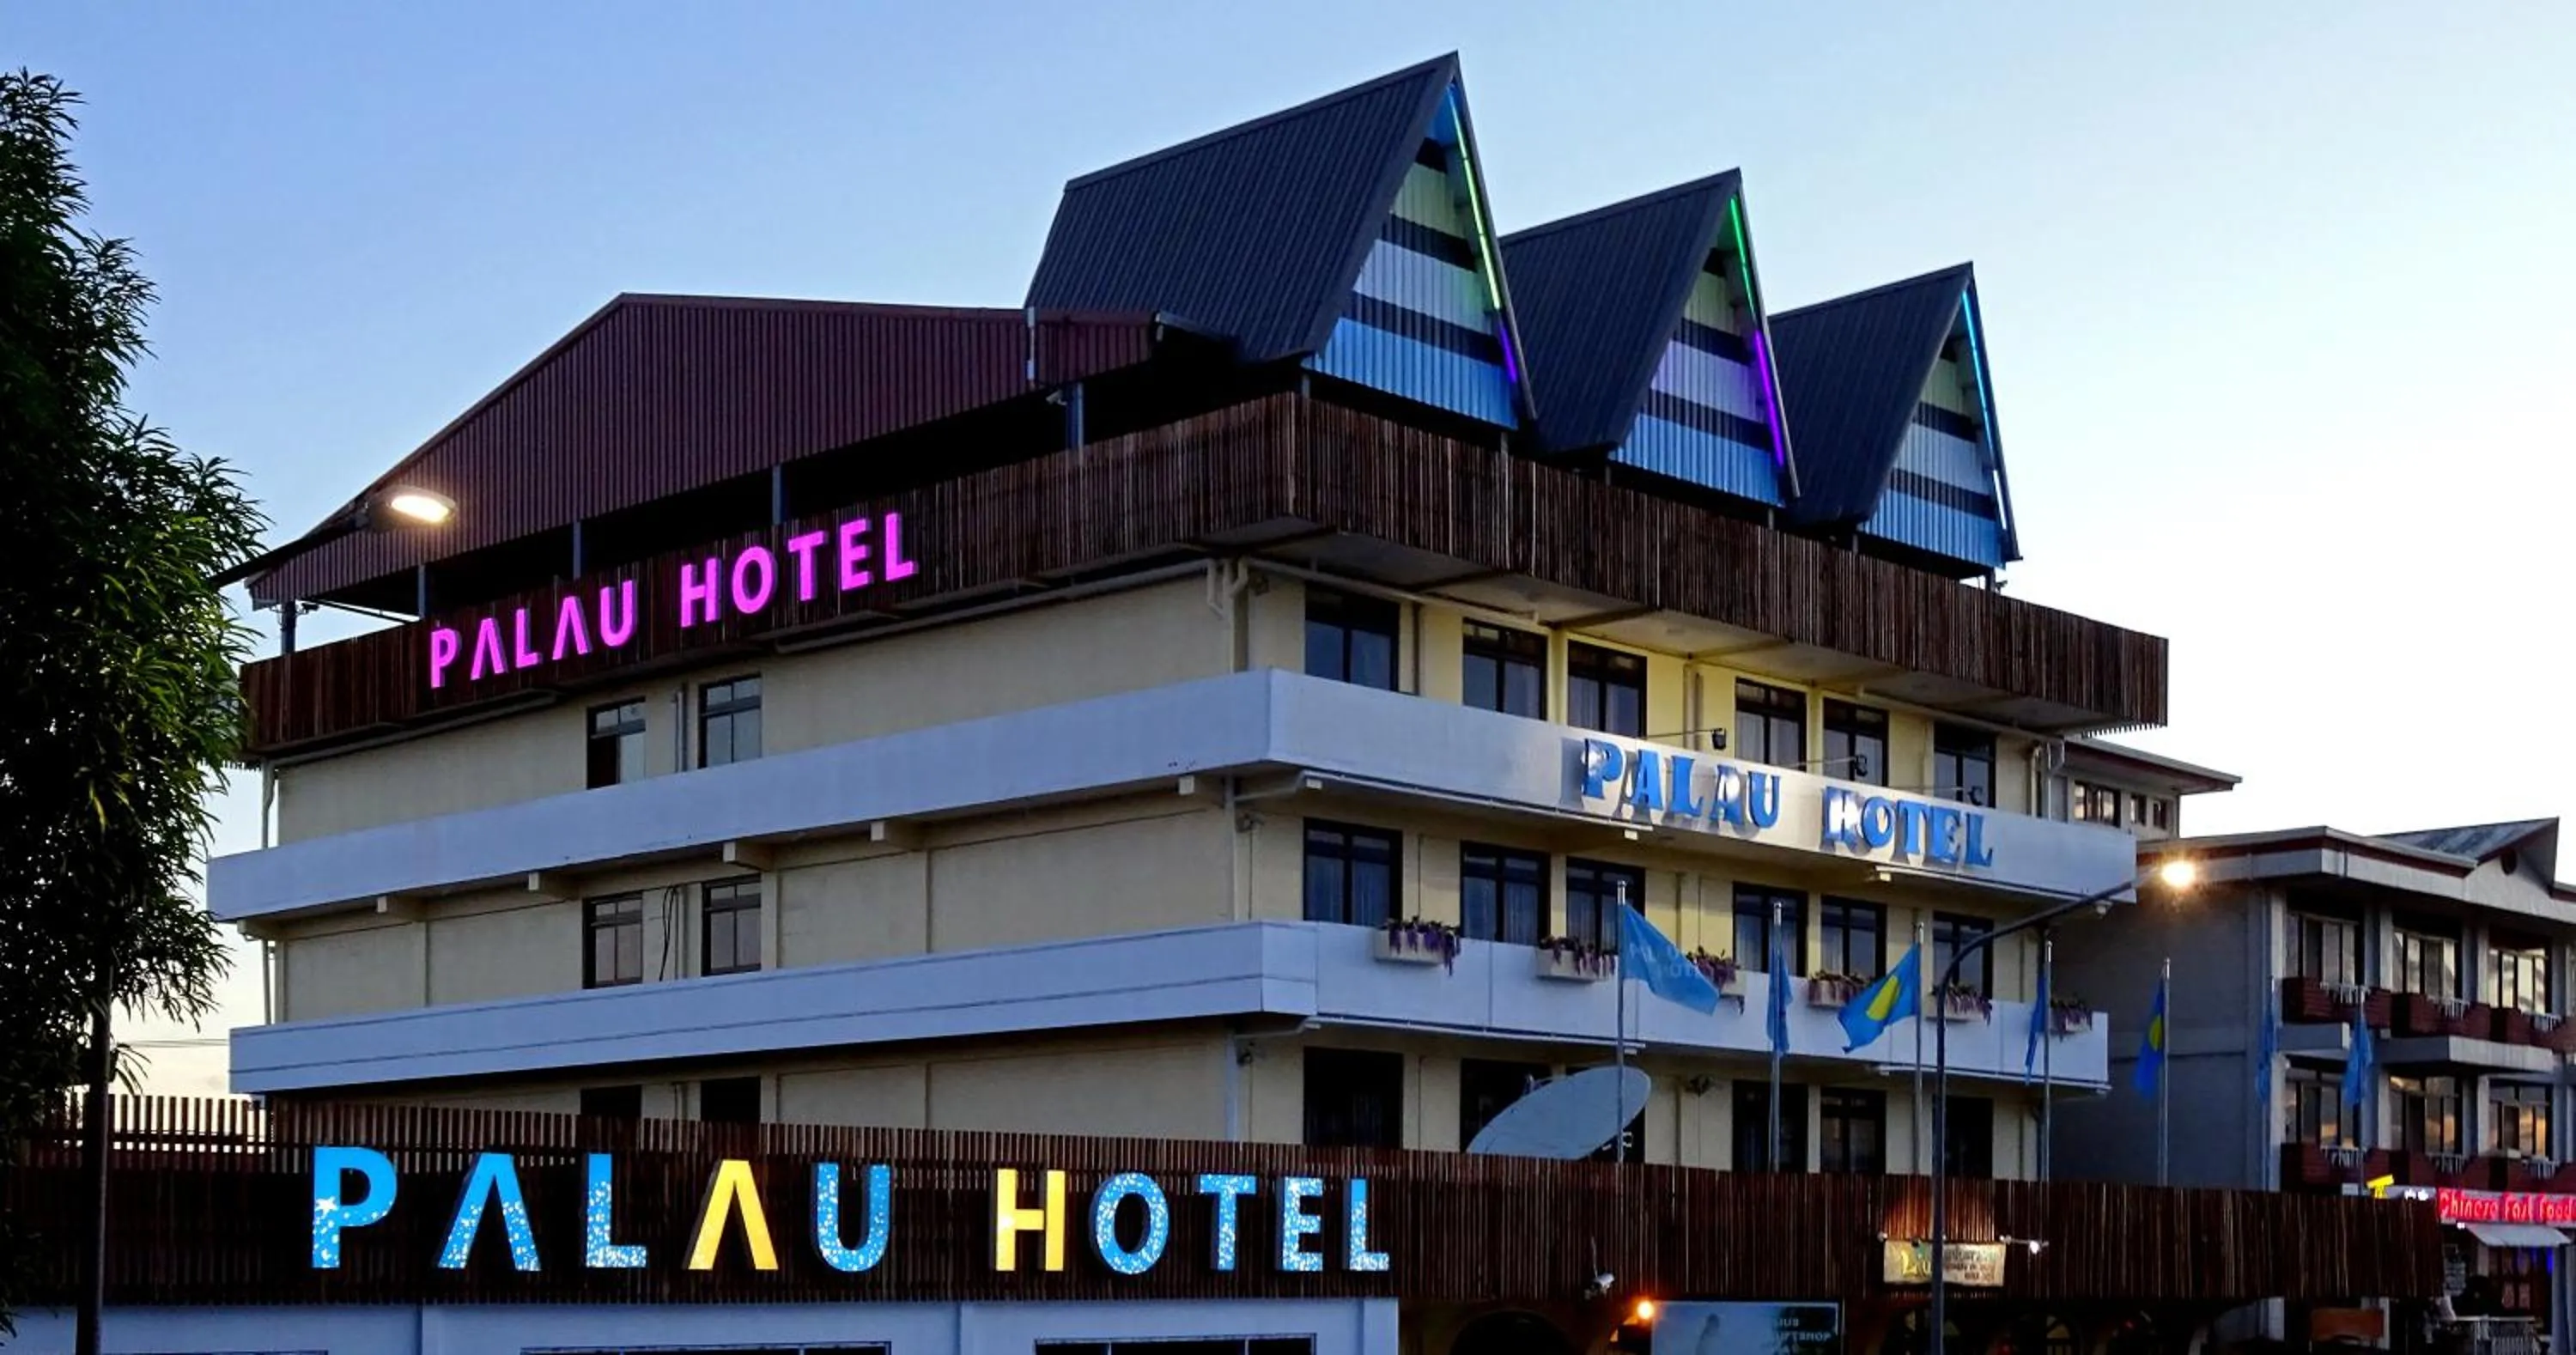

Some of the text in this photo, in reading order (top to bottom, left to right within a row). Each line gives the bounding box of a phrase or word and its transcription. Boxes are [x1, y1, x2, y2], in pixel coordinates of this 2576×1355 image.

[430, 512, 917, 689] PALAU HOTEL
[1581, 738, 1994, 867] PALAU HOTEL
[311, 1146, 1390, 1274] PALAU HOTEL
